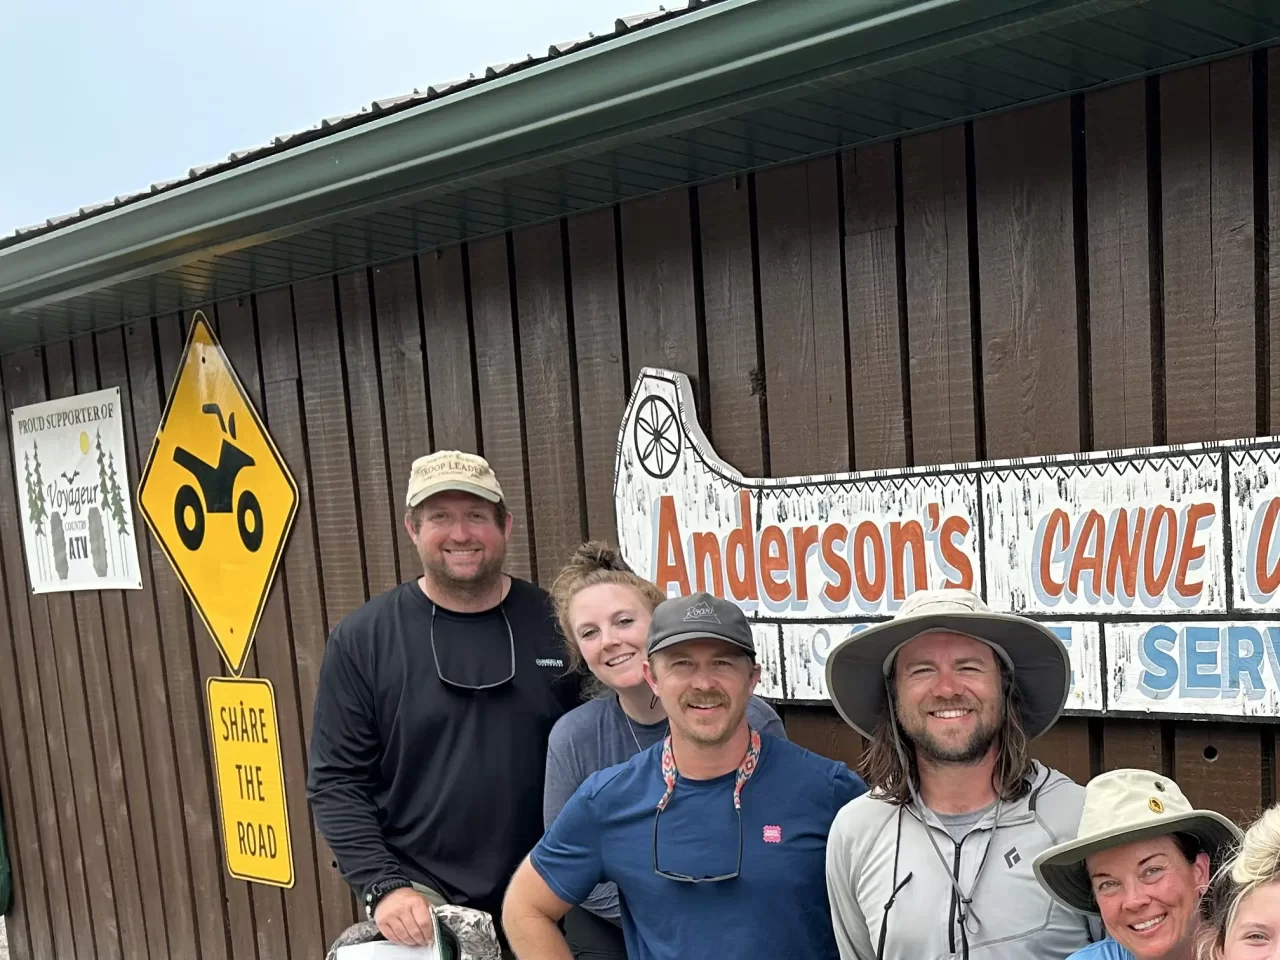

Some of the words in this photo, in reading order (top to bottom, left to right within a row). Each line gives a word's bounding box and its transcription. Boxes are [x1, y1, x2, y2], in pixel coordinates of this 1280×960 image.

[18, 416, 45, 435] PROUD
[46, 406, 100, 430] SUPPORTER
[100, 403, 114, 419] OF
[420, 462, 446, 477] TROOP
[46, 480, 99, 517] Voyageur
[64, 519, 88, 532] COUNTRY
[68, 535, 89, 561] ATV
[655, 490, 975, 604] Anderson's
[1038, 503, 1217, 600] CANOE
[220, 704, 268, 743] SHARE
[235, 764, 265, 802] THE
[237, 820, 278, 860] ROAD
